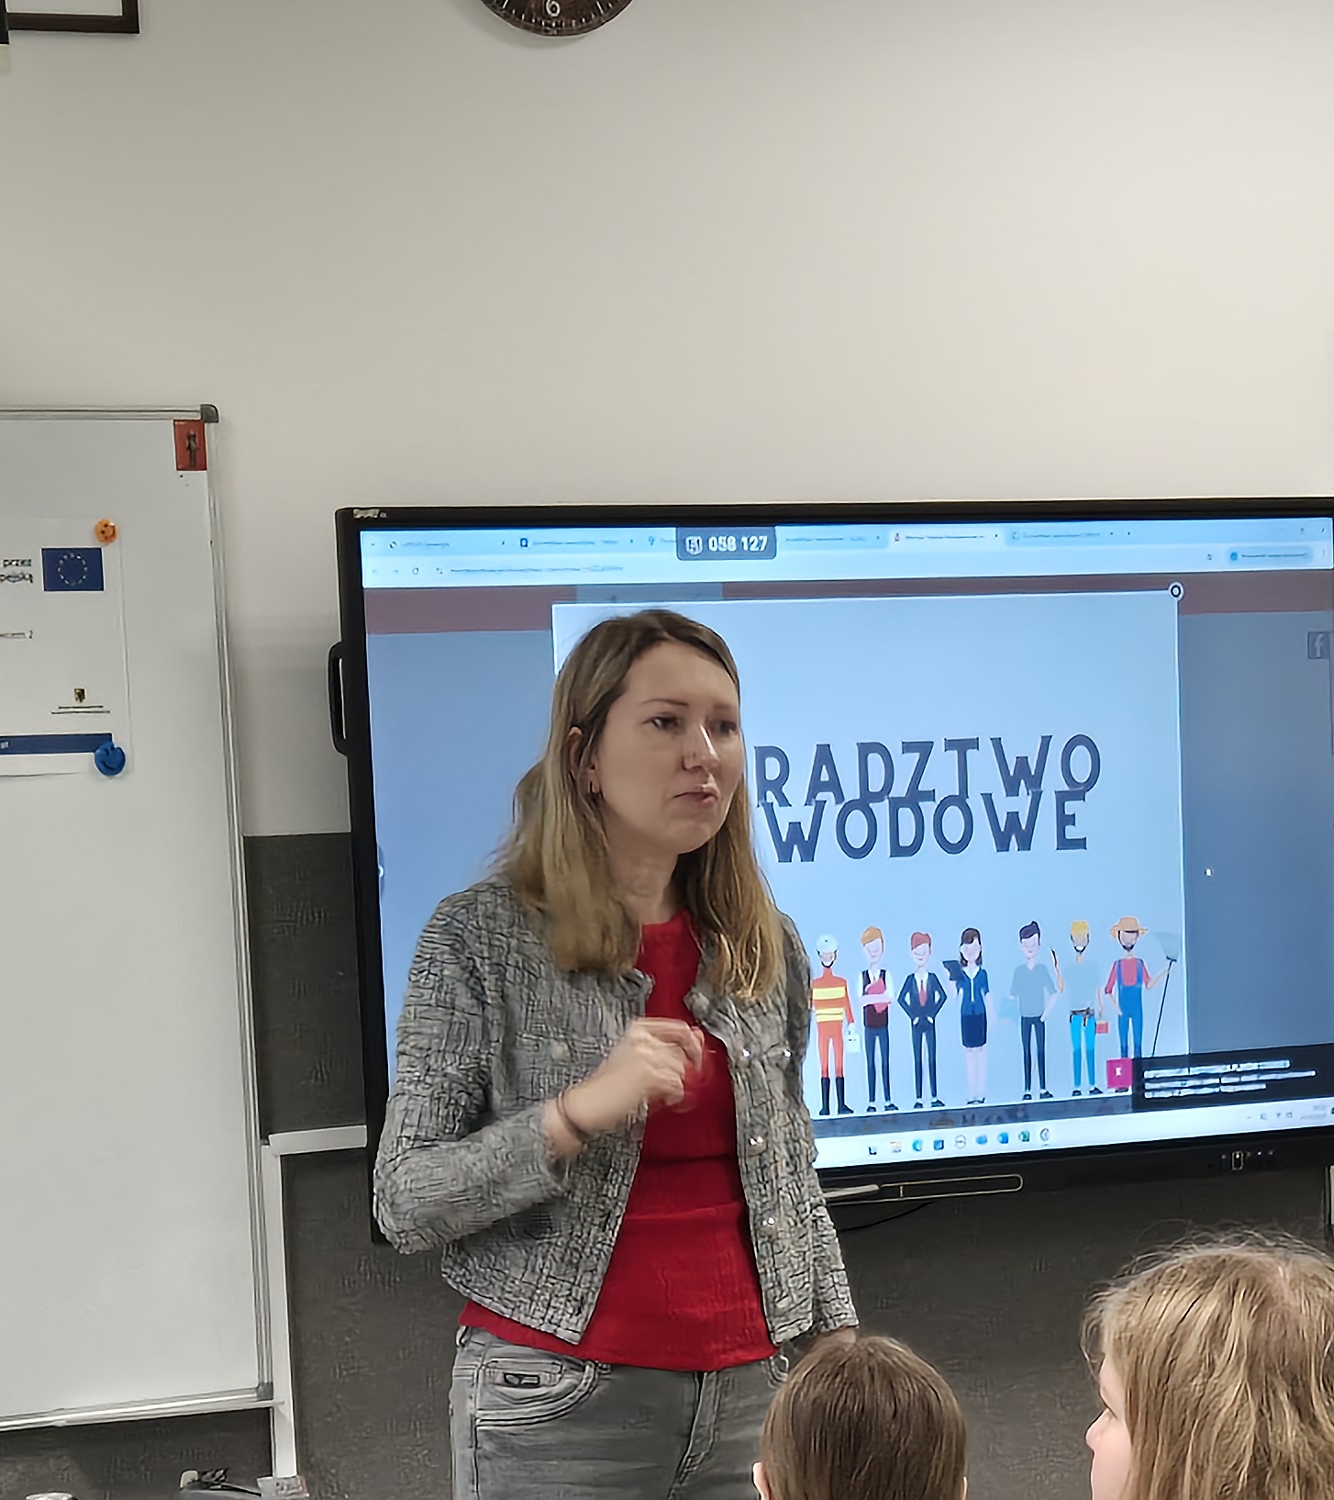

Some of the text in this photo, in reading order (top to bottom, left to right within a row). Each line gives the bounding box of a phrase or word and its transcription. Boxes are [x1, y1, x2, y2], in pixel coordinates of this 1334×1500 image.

[741, 535, 768, 552] 127
[754, 734, 1102, 807] RADZTWO
[762, 790, 1089, 864] WODOWE
